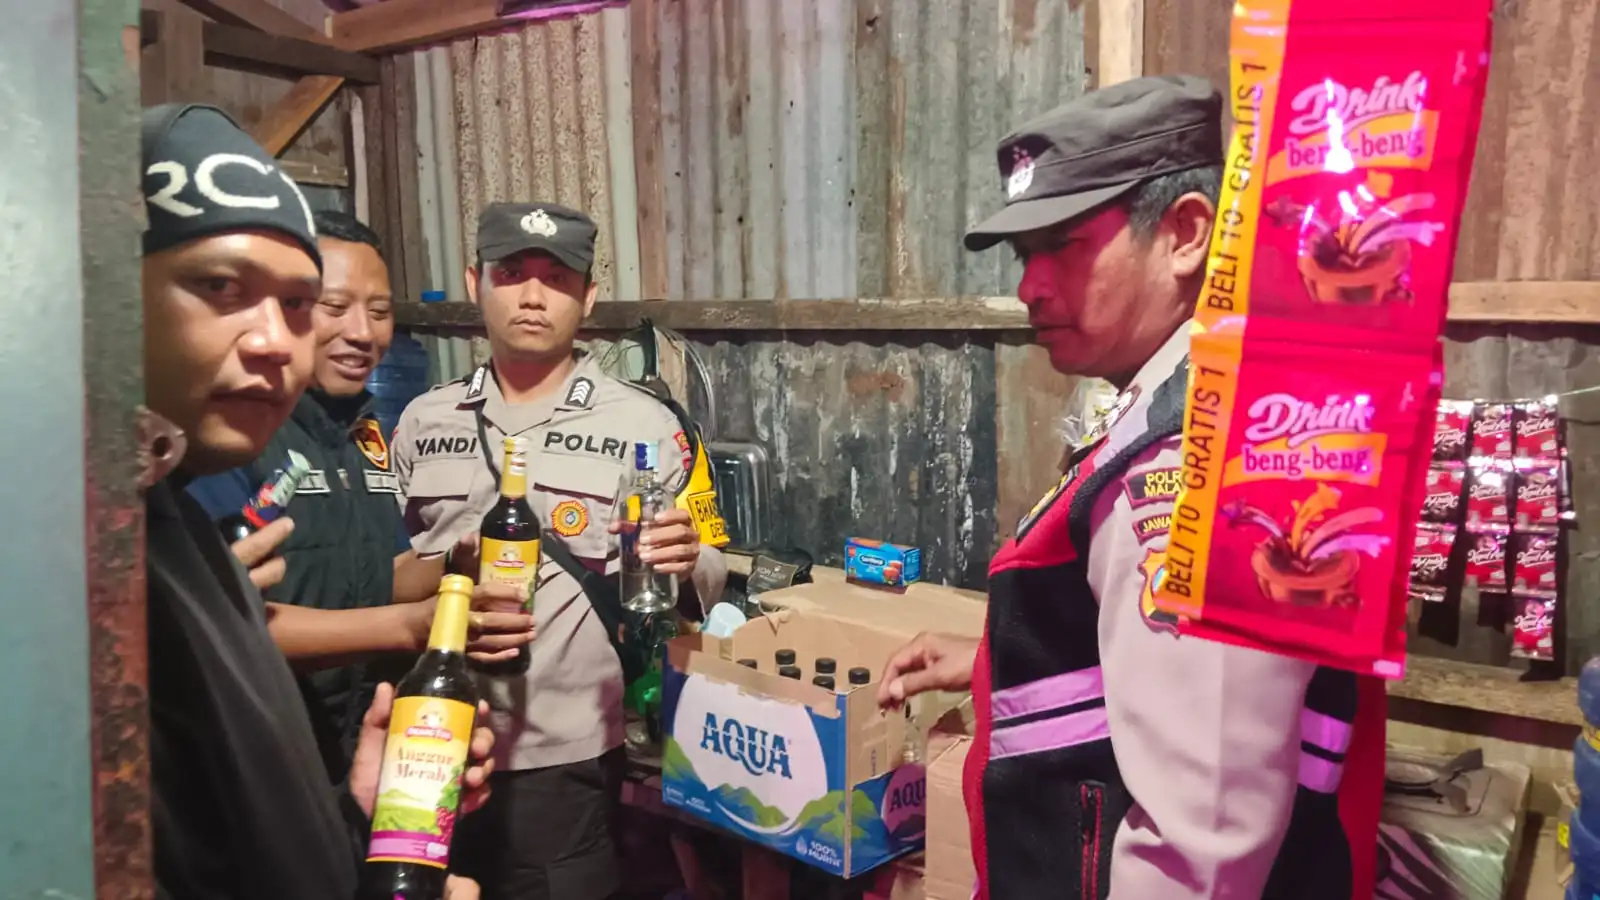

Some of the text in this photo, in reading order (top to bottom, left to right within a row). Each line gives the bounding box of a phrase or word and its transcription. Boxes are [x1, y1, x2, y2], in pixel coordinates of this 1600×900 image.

[1289, 70, 1425, 134] Drink
[1207, 61, 1268, 311] BELI 10 GRATIS 1
[415, 437, 478, 457] YANDI
[543, 431, 627, 460] POLRI
[1245, 393, 1375, 449] Drink
[1165, 365, 1226, 598] BELI 10 GRATIS 1
[1244, 444, 1370, 477] beng-beng
[700, 711, 793, 780] AQUA
